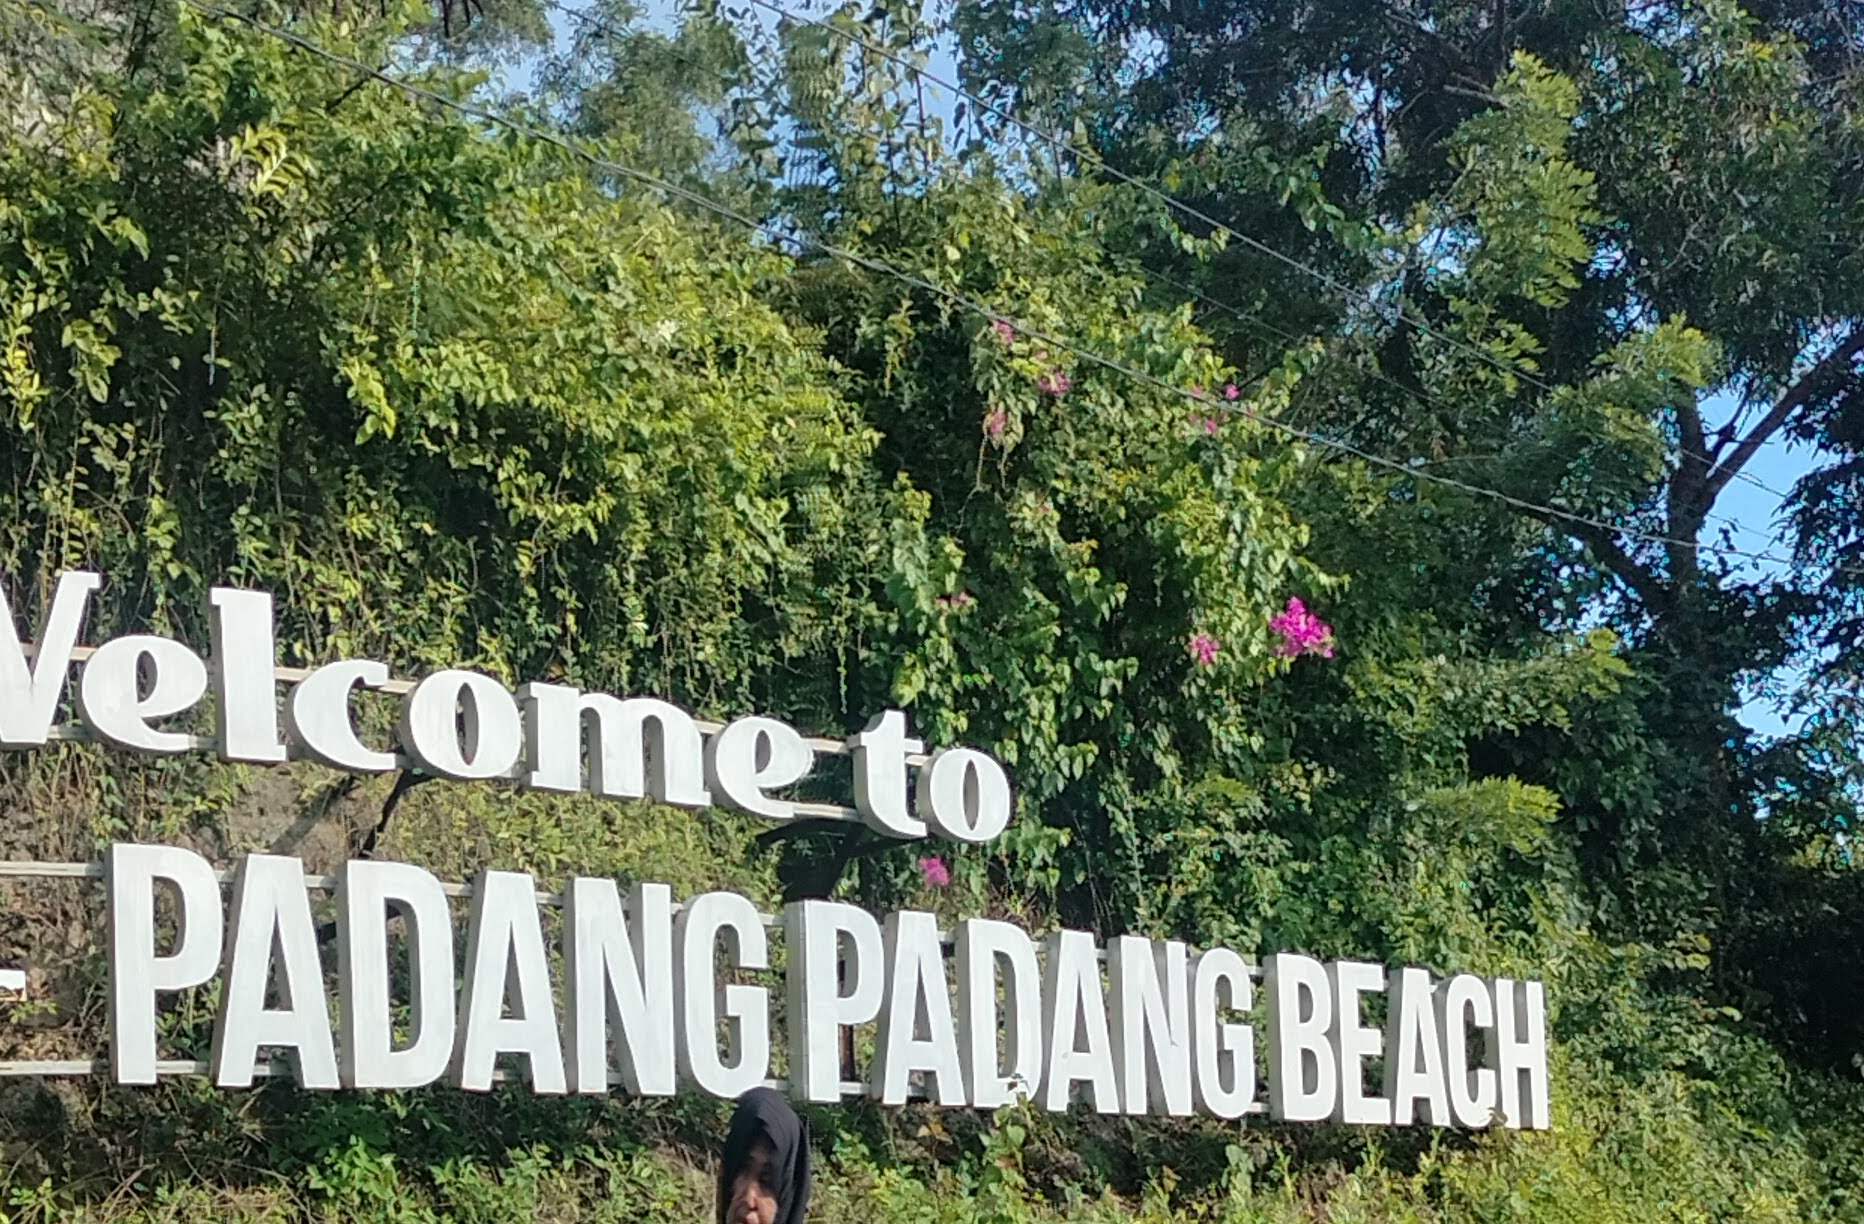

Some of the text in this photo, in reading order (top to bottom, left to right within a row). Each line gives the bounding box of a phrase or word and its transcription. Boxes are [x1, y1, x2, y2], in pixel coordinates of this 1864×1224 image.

[848, 709, 1011, 842] to
[105, 842, 770, 1099] PADANG
[786, 899, 1257, 1121] PADANG
[1267, 952, 1551, 1131] BEACH
